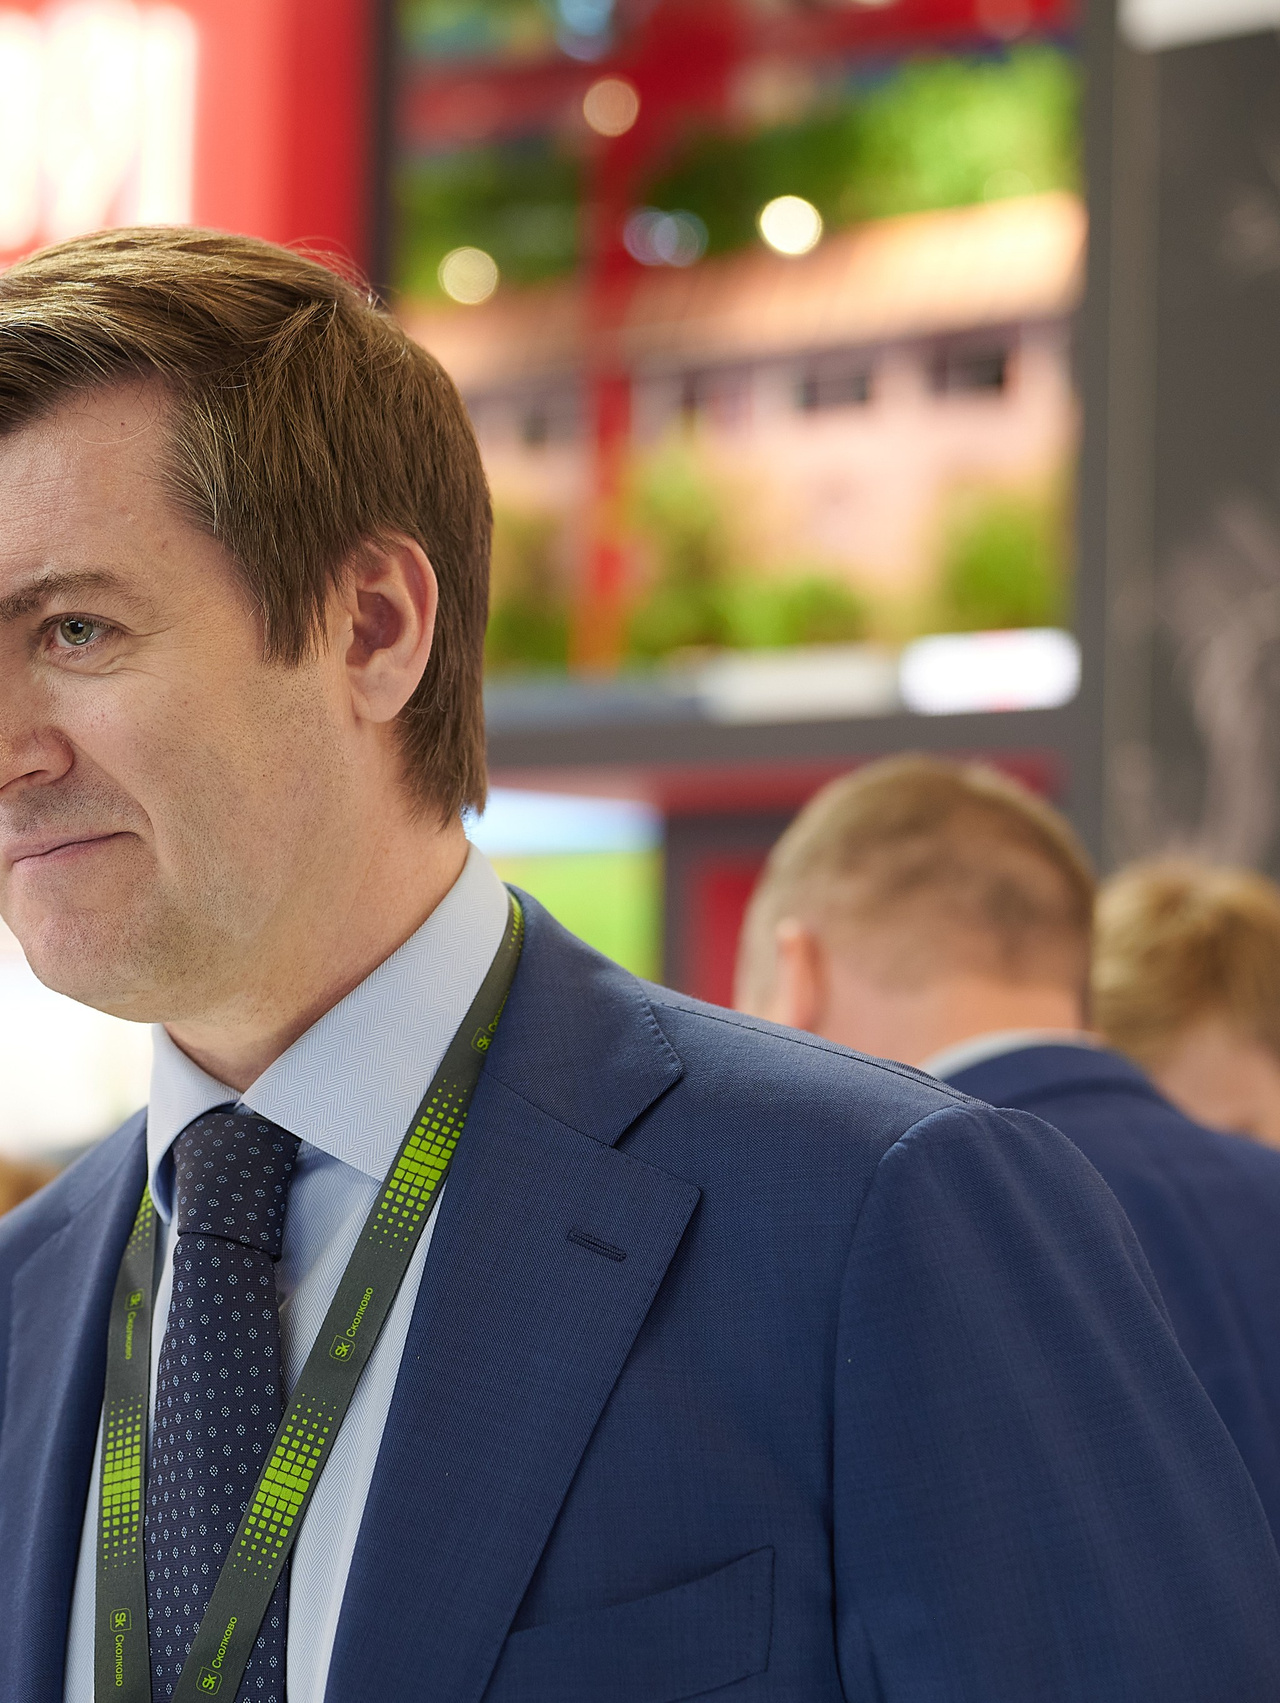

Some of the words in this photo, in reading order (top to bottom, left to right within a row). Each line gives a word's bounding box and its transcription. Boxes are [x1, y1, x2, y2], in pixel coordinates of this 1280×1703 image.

[346, 1287, 373, 1337] Сколково
[115, 1634, 125, 1687] Сколково
[212, 1616, 238, 1669] Сколково
